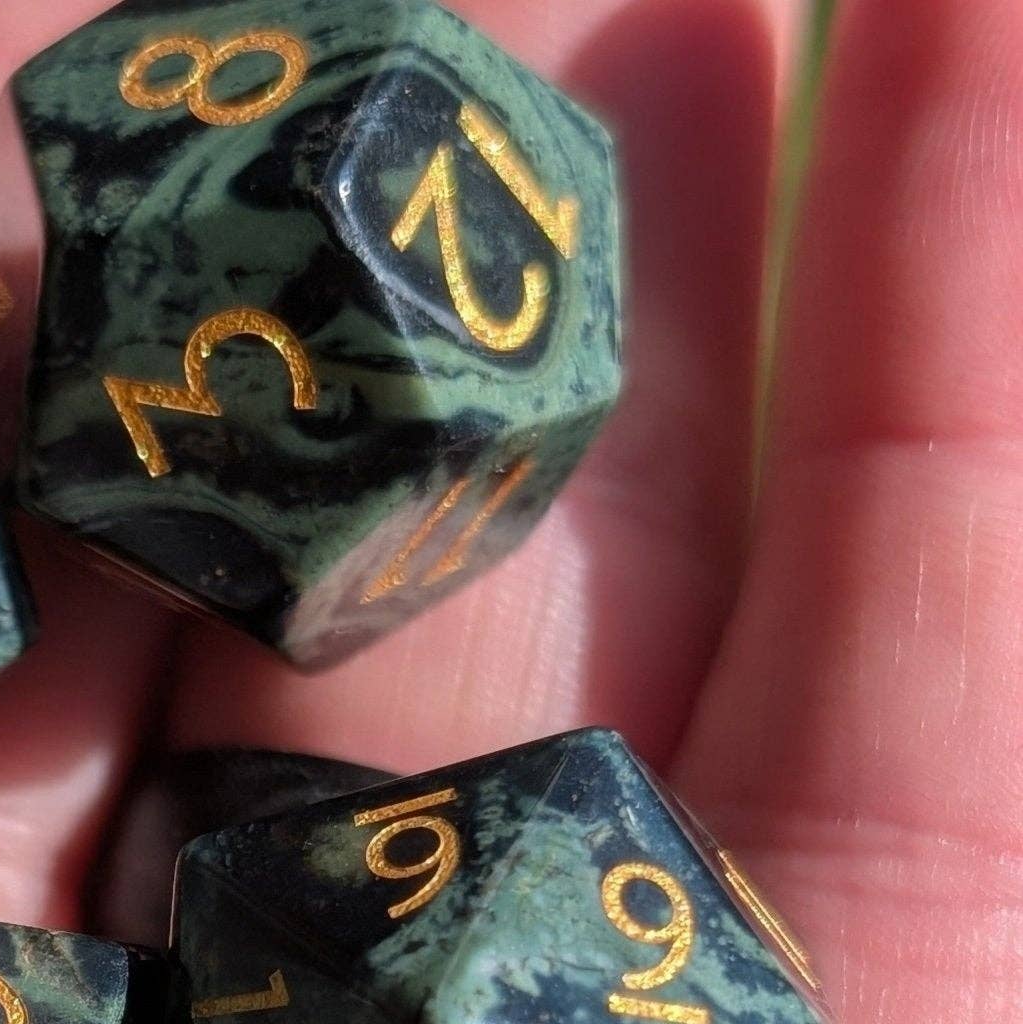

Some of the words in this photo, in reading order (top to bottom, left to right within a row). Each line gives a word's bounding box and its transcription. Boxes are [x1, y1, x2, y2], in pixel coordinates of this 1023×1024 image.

[119, 30, 309, 127] 8
[390, 100, 578, 352] 12
[103, 308, 317, 478] 3
